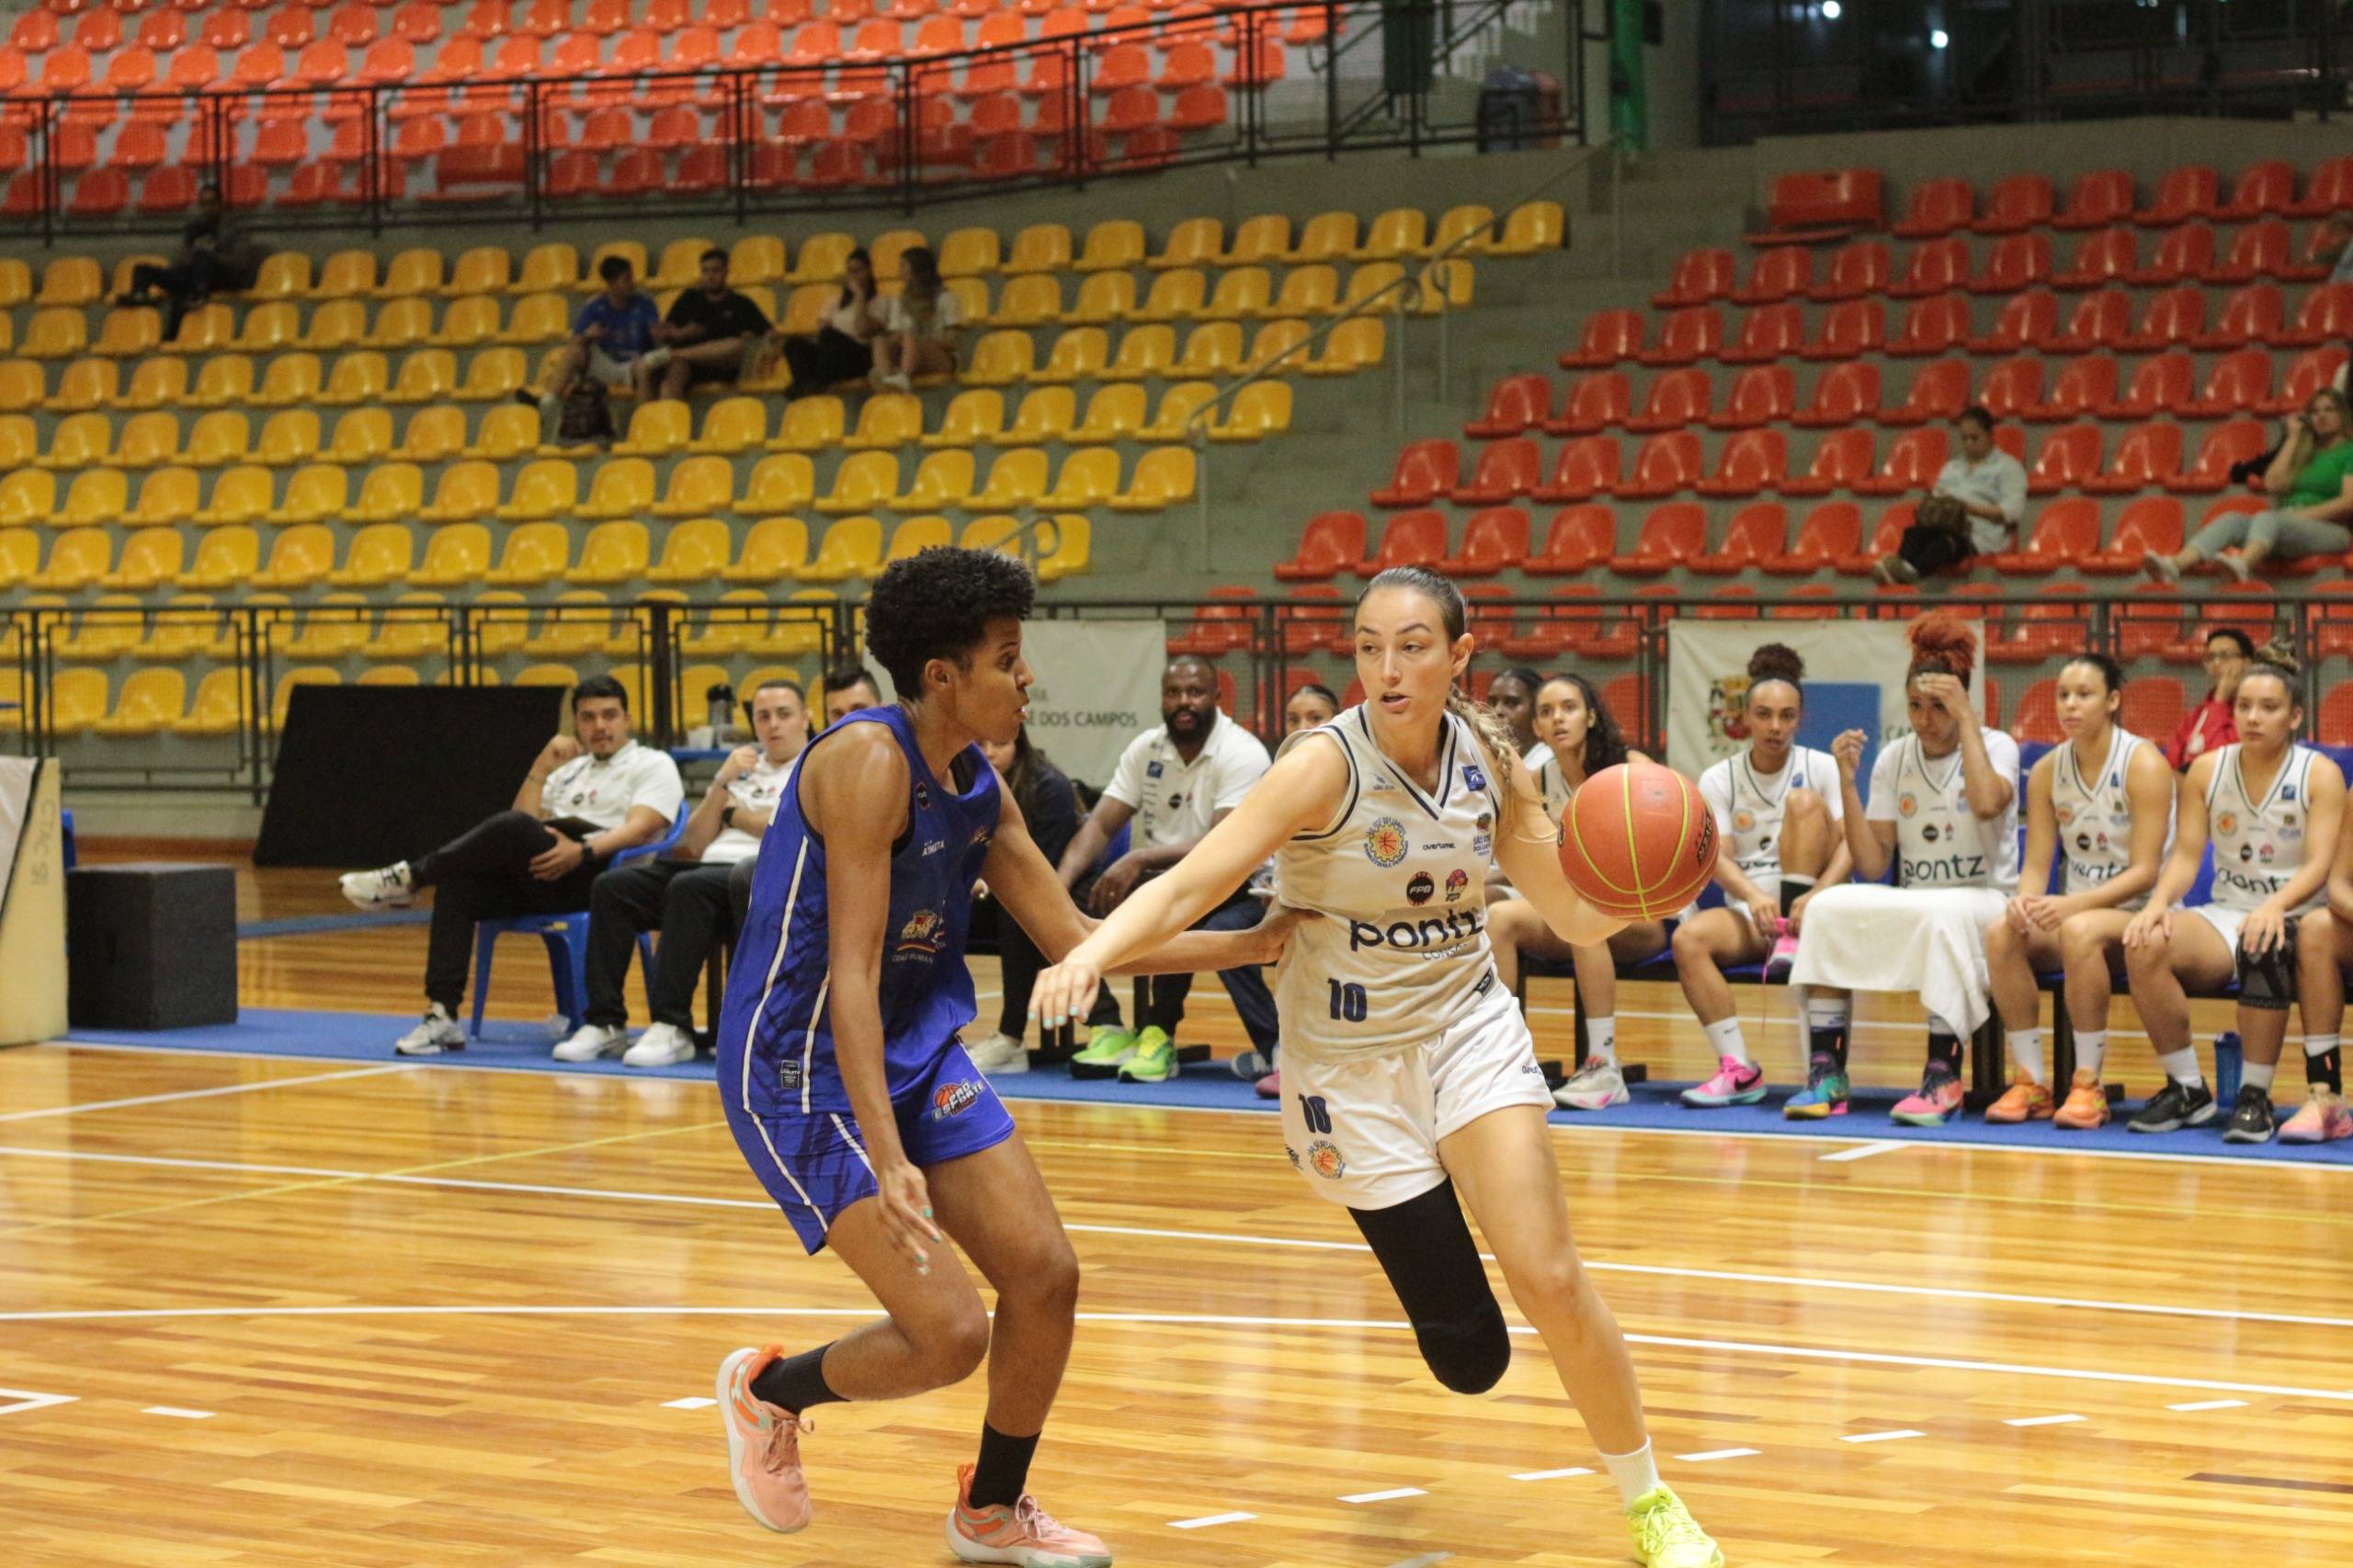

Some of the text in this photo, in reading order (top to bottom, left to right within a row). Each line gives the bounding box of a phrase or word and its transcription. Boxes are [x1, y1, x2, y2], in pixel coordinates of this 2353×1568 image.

[1040, 711, 1070, 727] DOS
[1074, 711, 1137, 727] CAMPOS
[1327, 977, 1368, 1022] 10
[1298, 1093, 1333, 1134] 10
